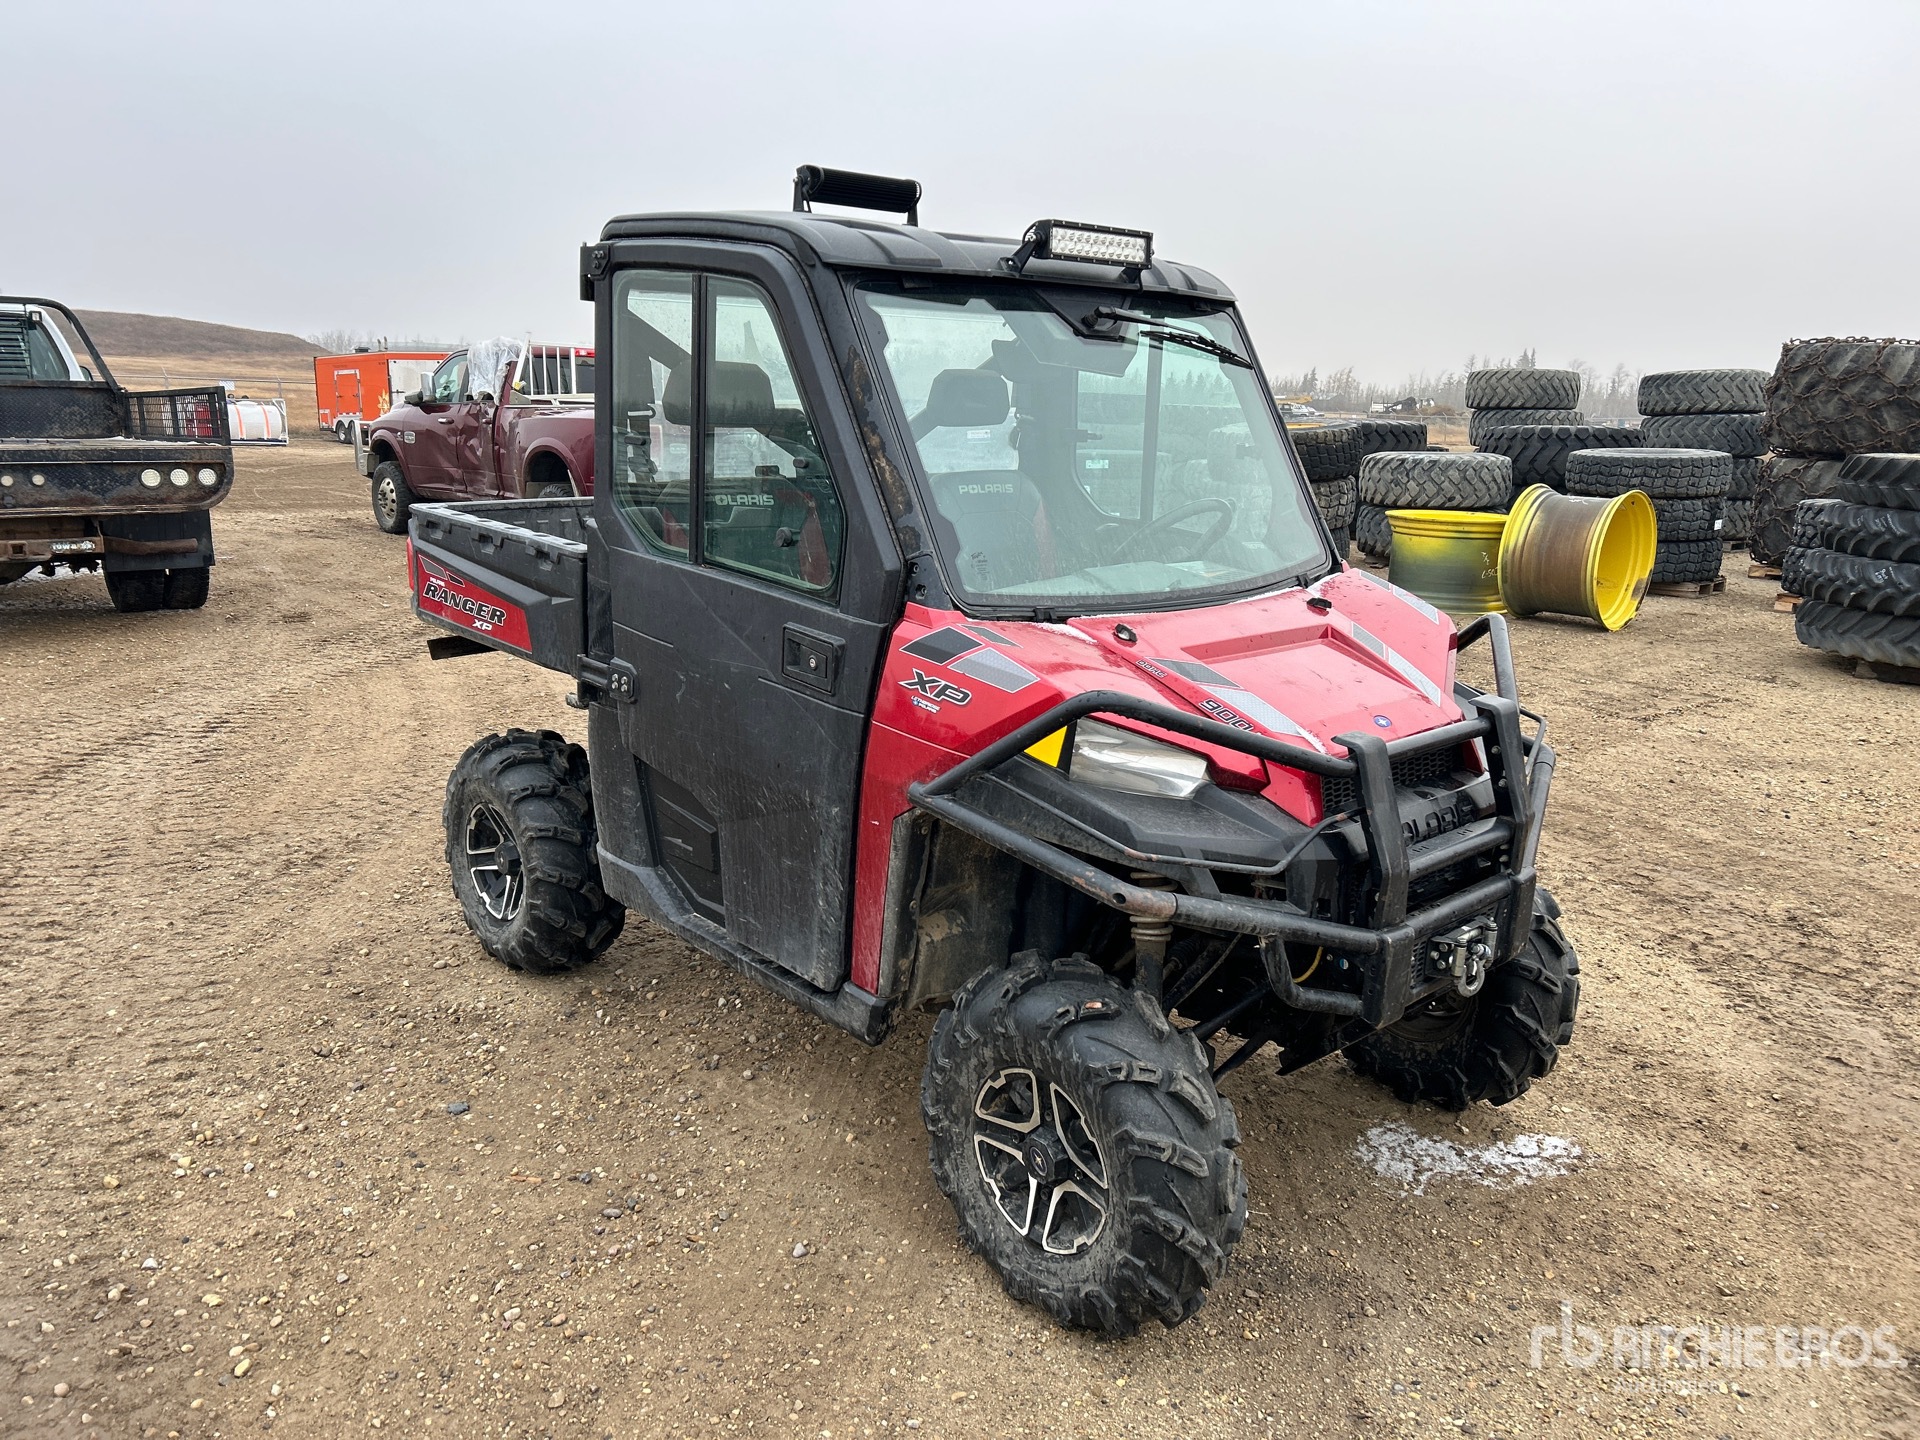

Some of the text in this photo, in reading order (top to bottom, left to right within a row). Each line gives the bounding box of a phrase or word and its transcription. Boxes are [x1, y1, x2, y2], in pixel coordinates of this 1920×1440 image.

[713, 494, 775, 506] OLARIS
[958, 484, 1014, 494] POLARIS
[423, 582, 507, 626] RANGER
[472, 619, 493, 631] XP
[898, 668, 972, 705] XP
[1199, 698, 1254, 732] 900
